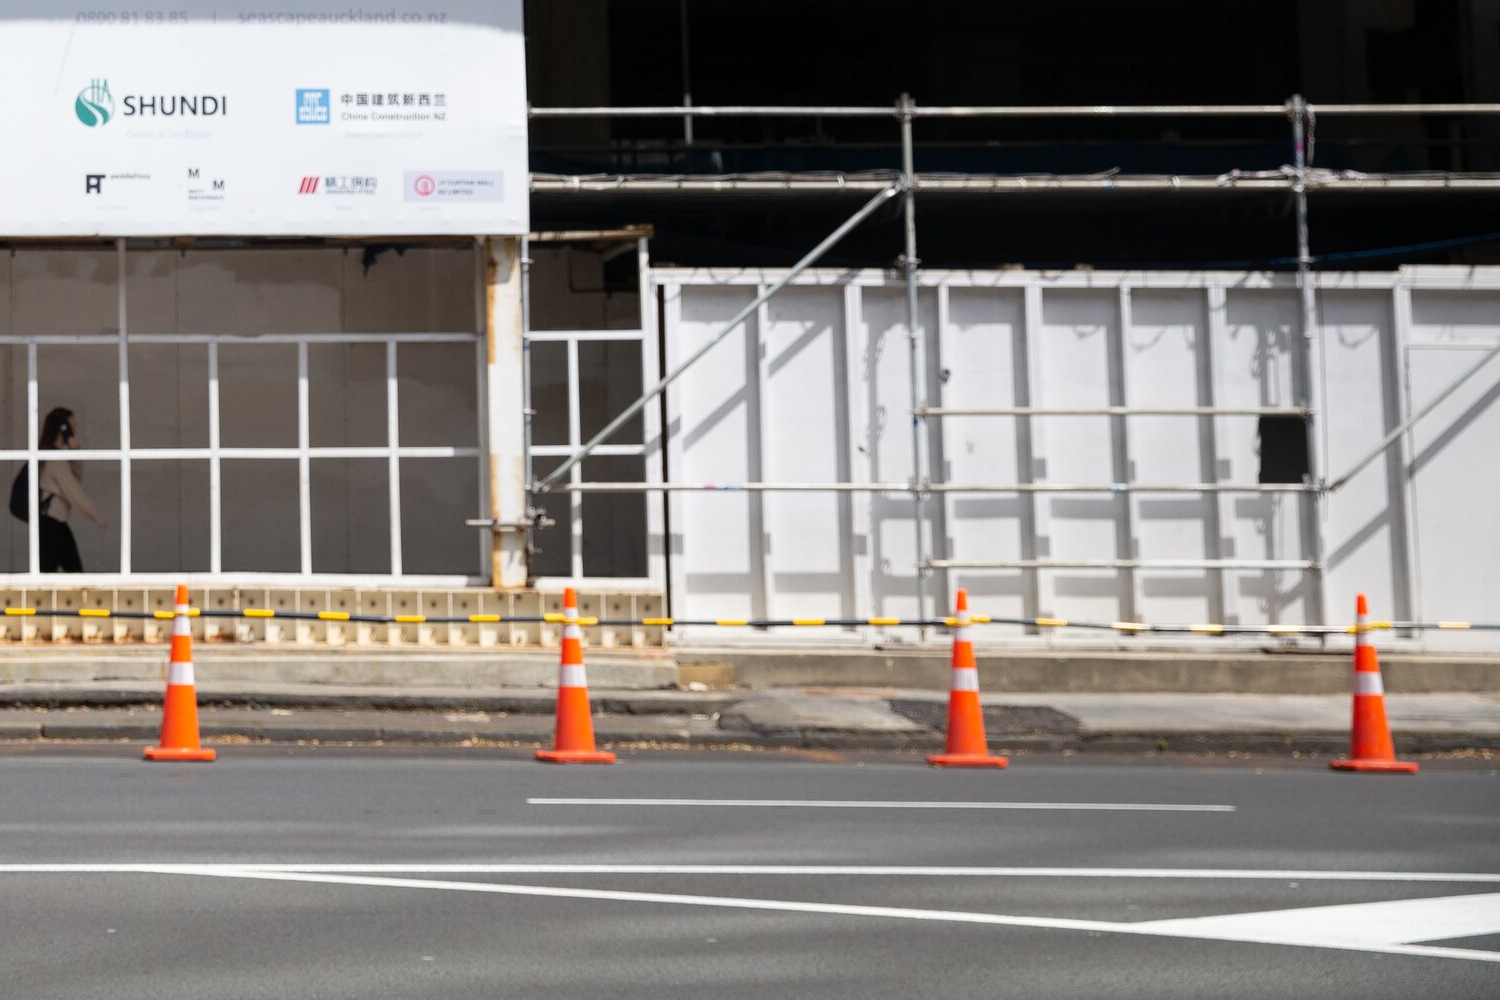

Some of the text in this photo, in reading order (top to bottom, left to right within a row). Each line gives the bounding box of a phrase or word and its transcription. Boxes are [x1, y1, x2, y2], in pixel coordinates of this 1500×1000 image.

[237, 8, 448, 27] seascapeauckland.co.nz
[123, 95, 227, 116] SHUNDI
[340, 93, 447, 107] 中国建筑新西兰
